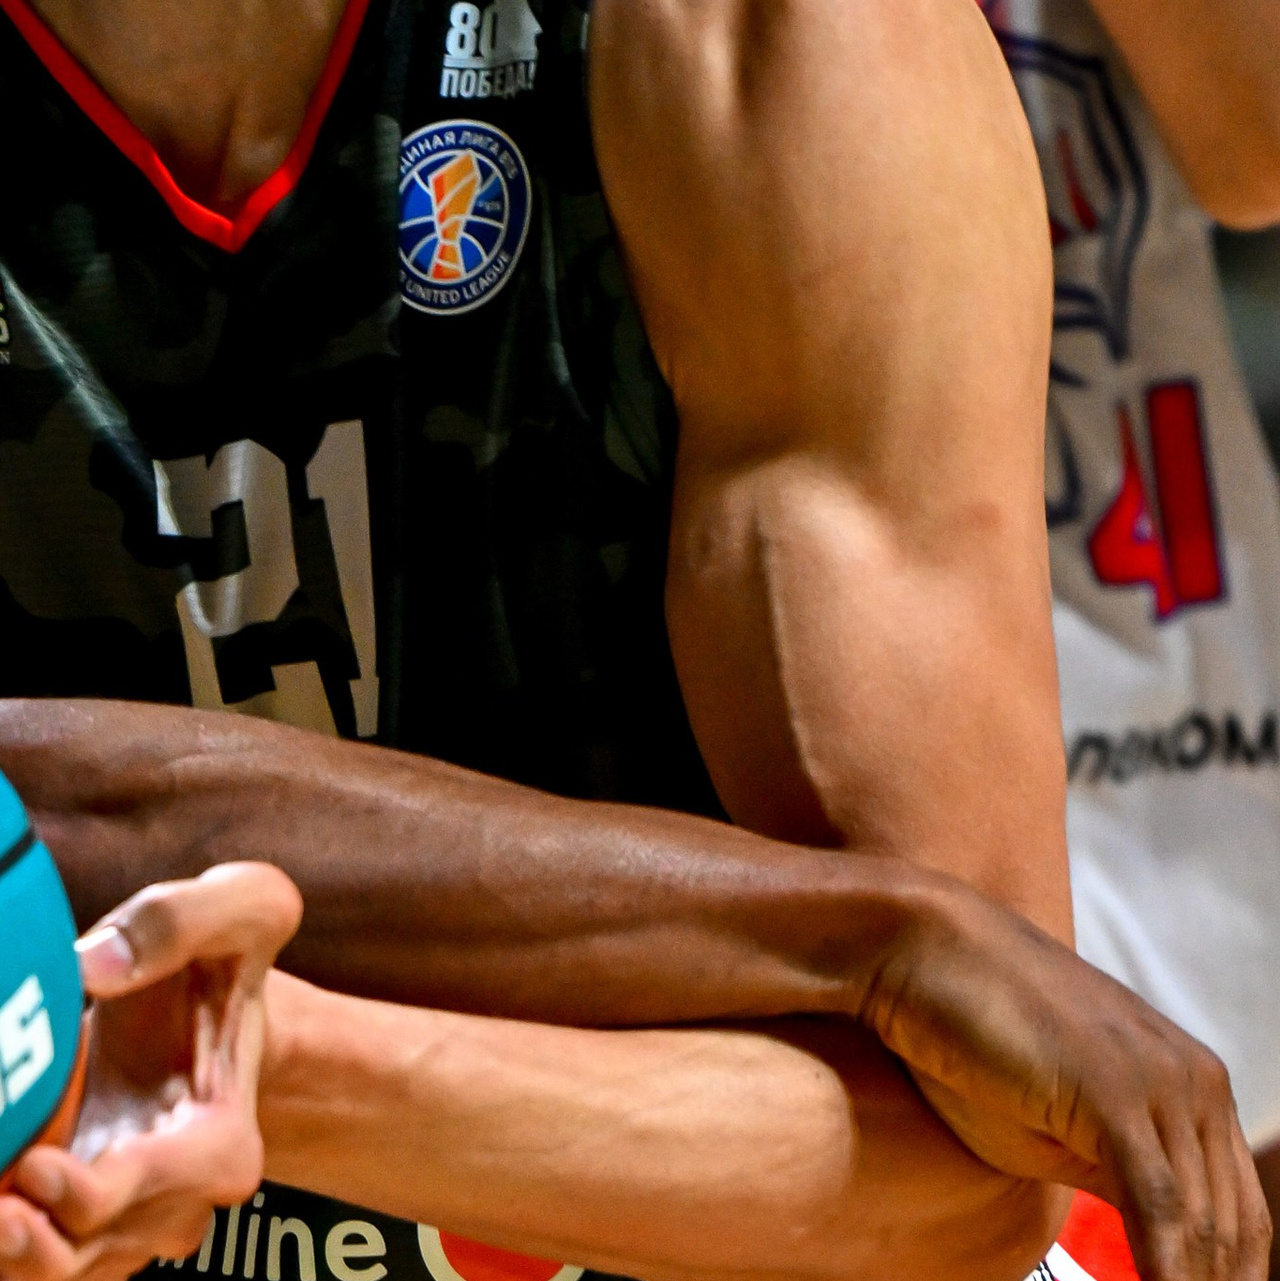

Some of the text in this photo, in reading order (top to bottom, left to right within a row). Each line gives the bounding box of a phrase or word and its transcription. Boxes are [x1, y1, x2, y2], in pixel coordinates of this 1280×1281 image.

[404, 250, 512, 306] UNITED LEAGUE
[152, 419, 380, 739] 21
